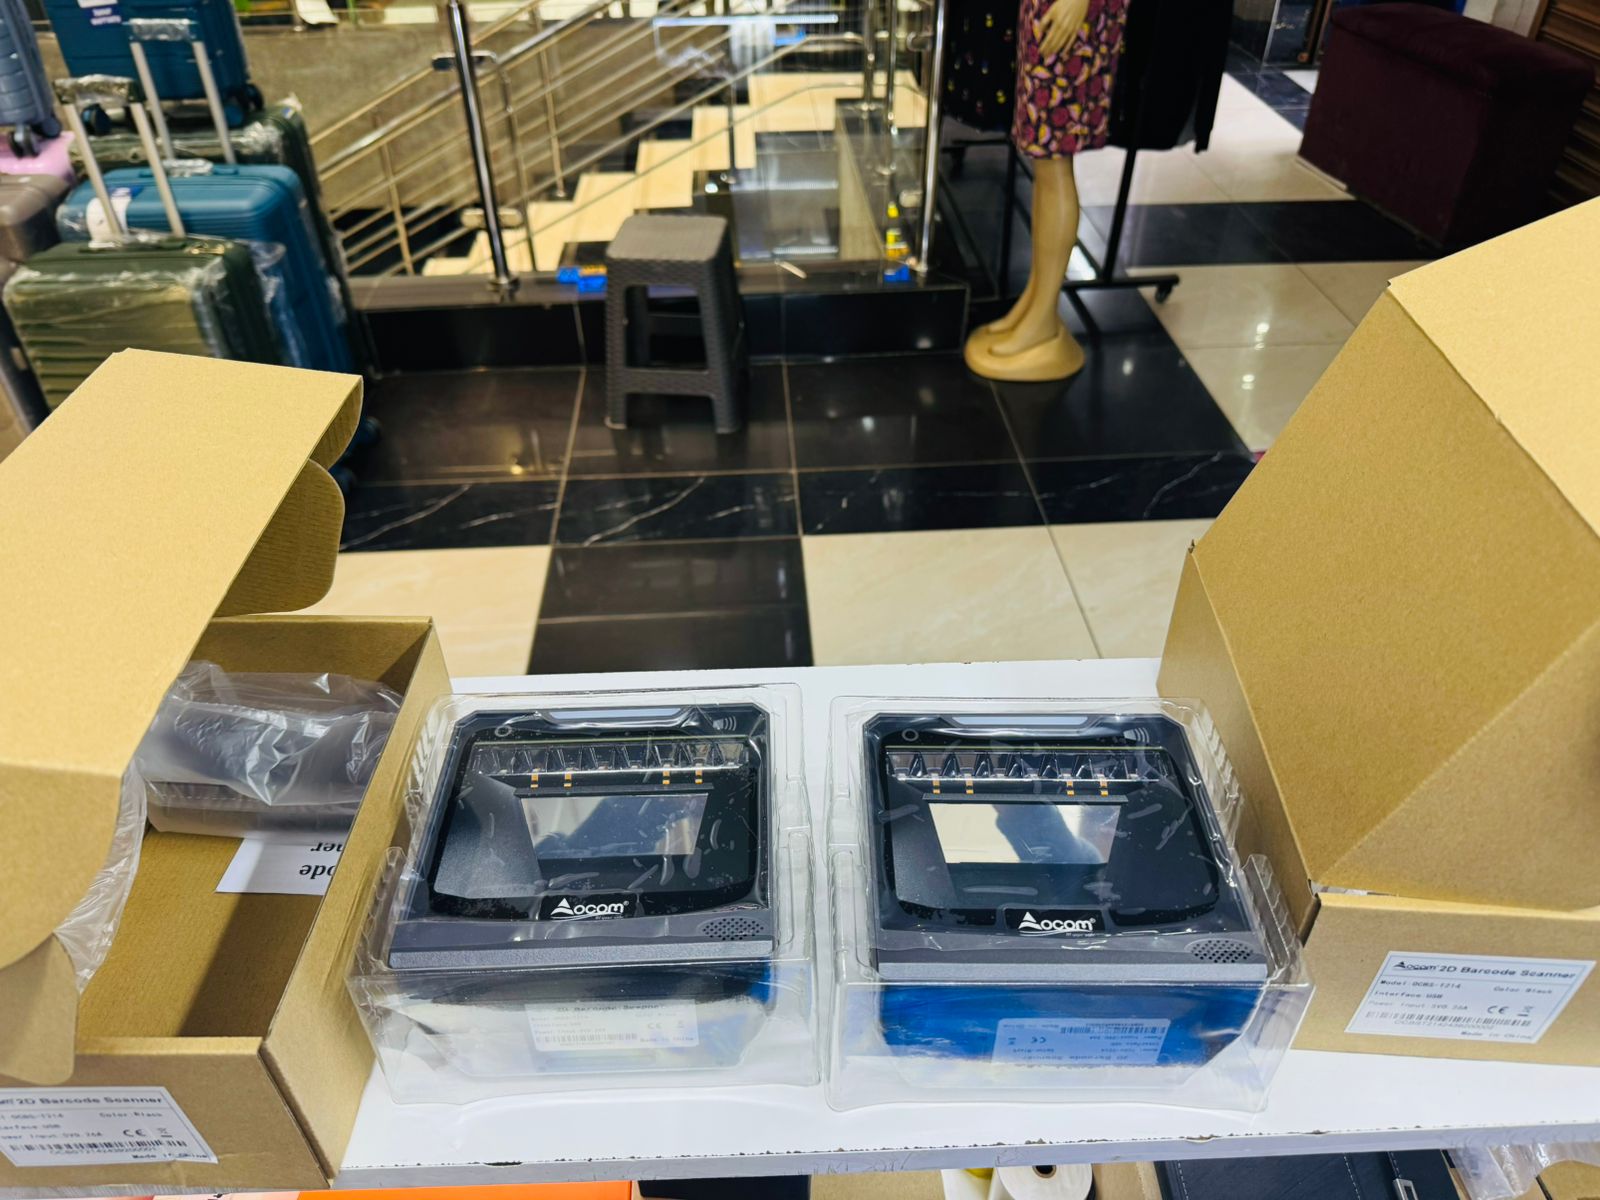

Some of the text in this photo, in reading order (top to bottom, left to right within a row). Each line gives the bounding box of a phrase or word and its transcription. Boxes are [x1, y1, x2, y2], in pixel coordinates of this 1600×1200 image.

[1438, 965, 1458, 973] 2D
[1460, 966, 1517, 977] Barcode
[1520, 969, 1577, 980] Scanner
[39, 1096, 101, 1105] Barcode
[103, 1096, 162, 1104] Scanner
